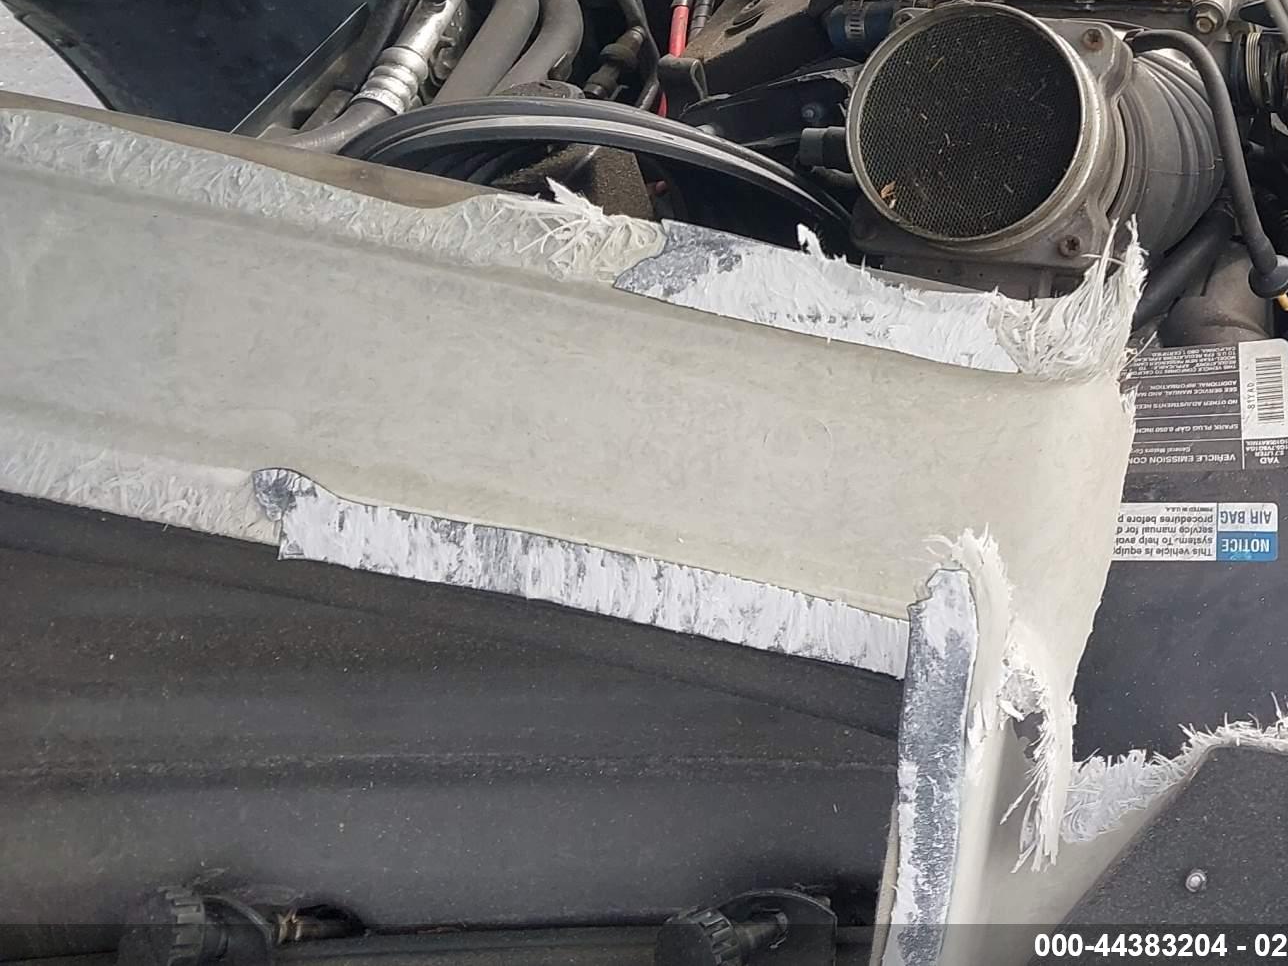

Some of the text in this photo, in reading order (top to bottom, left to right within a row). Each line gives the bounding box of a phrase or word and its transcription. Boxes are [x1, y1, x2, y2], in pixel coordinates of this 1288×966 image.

[1153, 400, 1202, 409] ADJUSTMENTS
[1149, 455, 1194, 464] EMISSION
[1196, 454, 1236, 462] VEHICLE
[1127, 516, 1156, 525] before
[1160, 514, 1213, 525] procedures
[1220, 511, 1271, 524] AIR BAG
[1125, 526, 1138, 535] for
[1142, 526, 1176, 535] manual
[1179, 526, 1213, 534] service
[1139, 536, 1158, 545] help
[1161, 537, 1173, 545] To
[1221, 539, 1270, 552] NOTICE
[1156, 548, 1190, 556] vehicle
[1193, 548, 1212, 556] This
